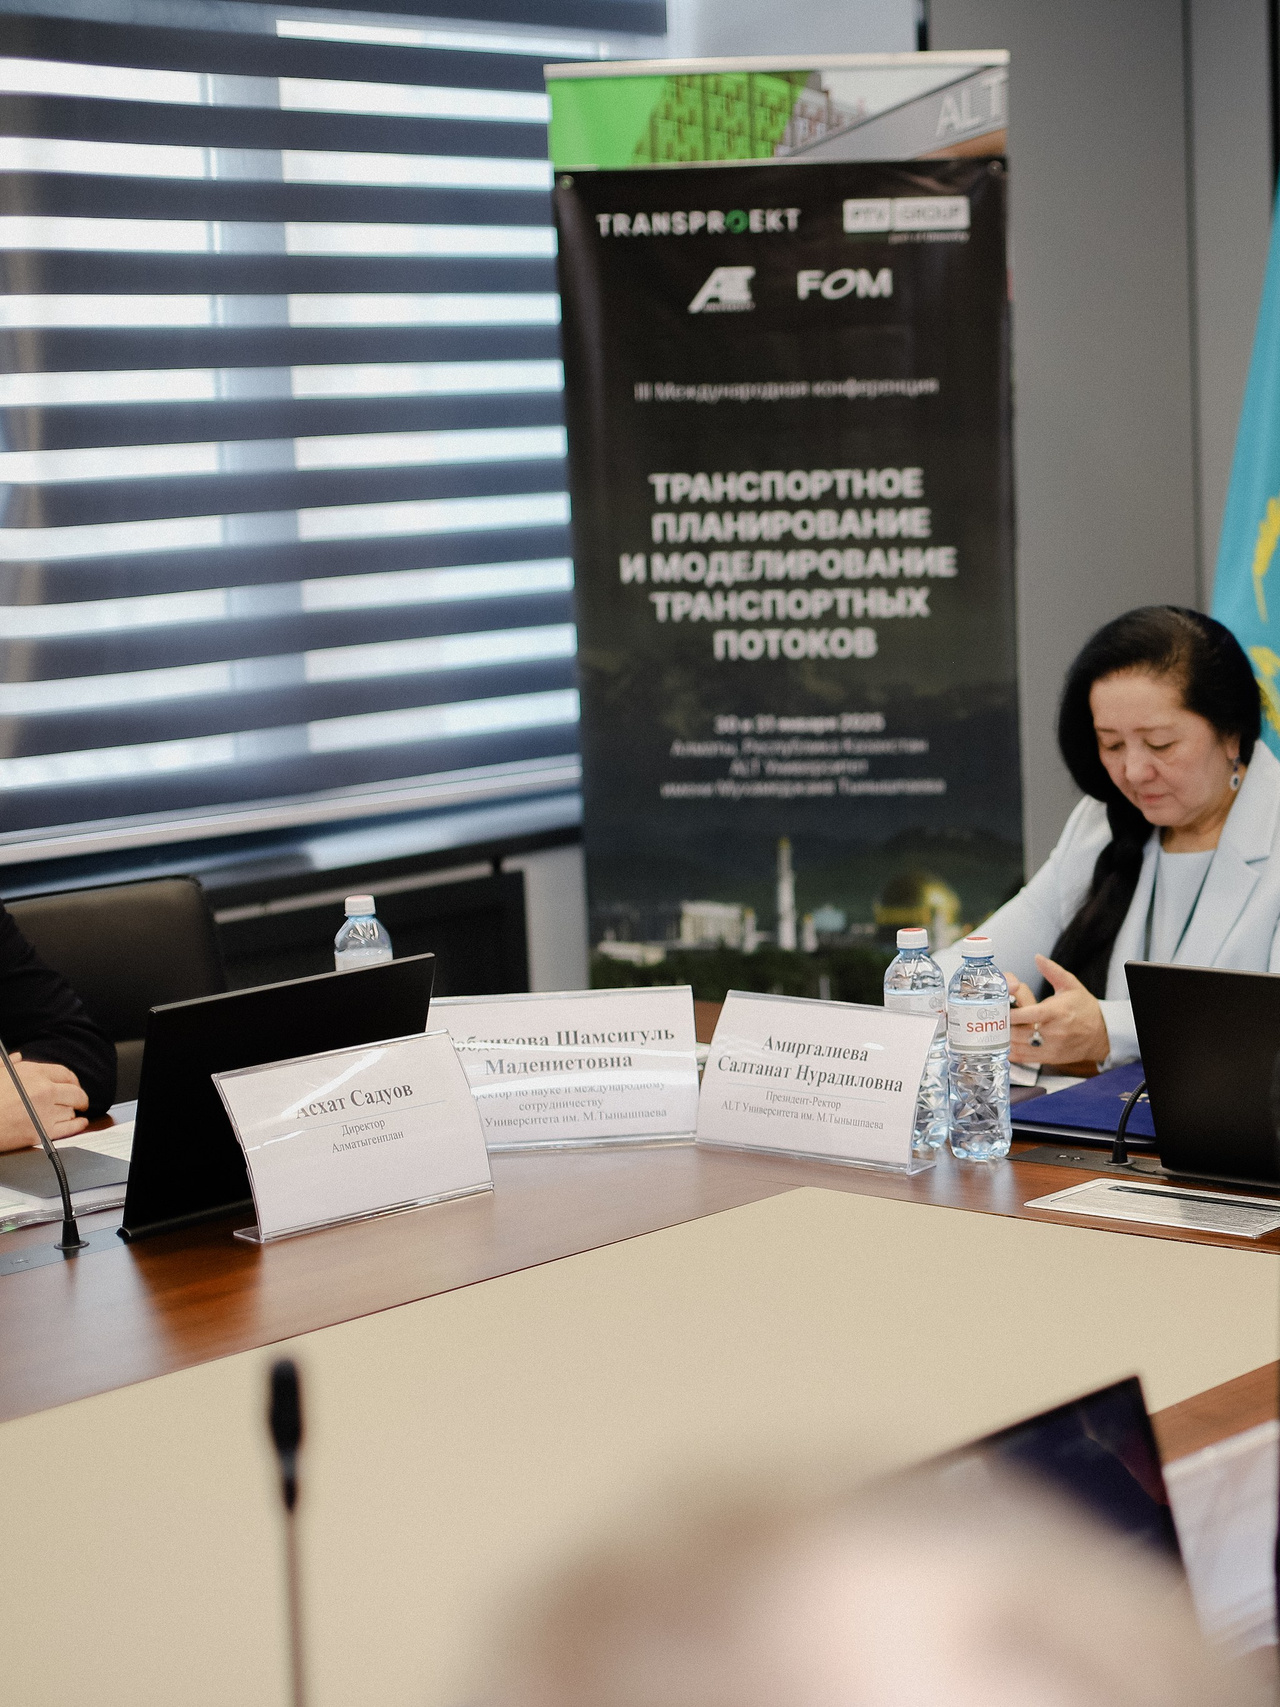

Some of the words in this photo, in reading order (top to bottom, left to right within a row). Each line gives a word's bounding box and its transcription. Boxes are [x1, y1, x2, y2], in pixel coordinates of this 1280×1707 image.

[595, 207, 801, 238] TRANSPROEKT
[797, 267, 893, 300] FOM
[648, 467, 924, 504] ТРАНСПОРТНОЕ
[651, 507, 931, 543] ПЛАНИРОВАНИЕ
[619, 553, 647, 584] И
[650, 546, 958, 587] МОДЕЛИРОВАНИЕ
[649, 587, 931, 622] ТРАНСПОРТНЫХ
[713, 627, 878, 660] ПОТОКОВ
[966, 1015, 1008, 1033] samal
[556, 1029, 675, 1046] Шамсигуль
[761, 1035, 869, 1062] Амиргалиева
[485, 1055, 632, 1075] Мадениетовна
[718, 1055, 792, 1079] Салтанат
[796, 1064, 903, 1092] Нурадиловна
[350, 1084, 413, 1106] Садуов
[518, 1098, 604, 1113] сотрудничеству
[485, 1115, 560, 1128] Университета
[742, 1103, 799, 1120] Университета
[341, 1119, 386, 1137] Директор
[332, 1131, 404, 1153] Алматыгенплан
